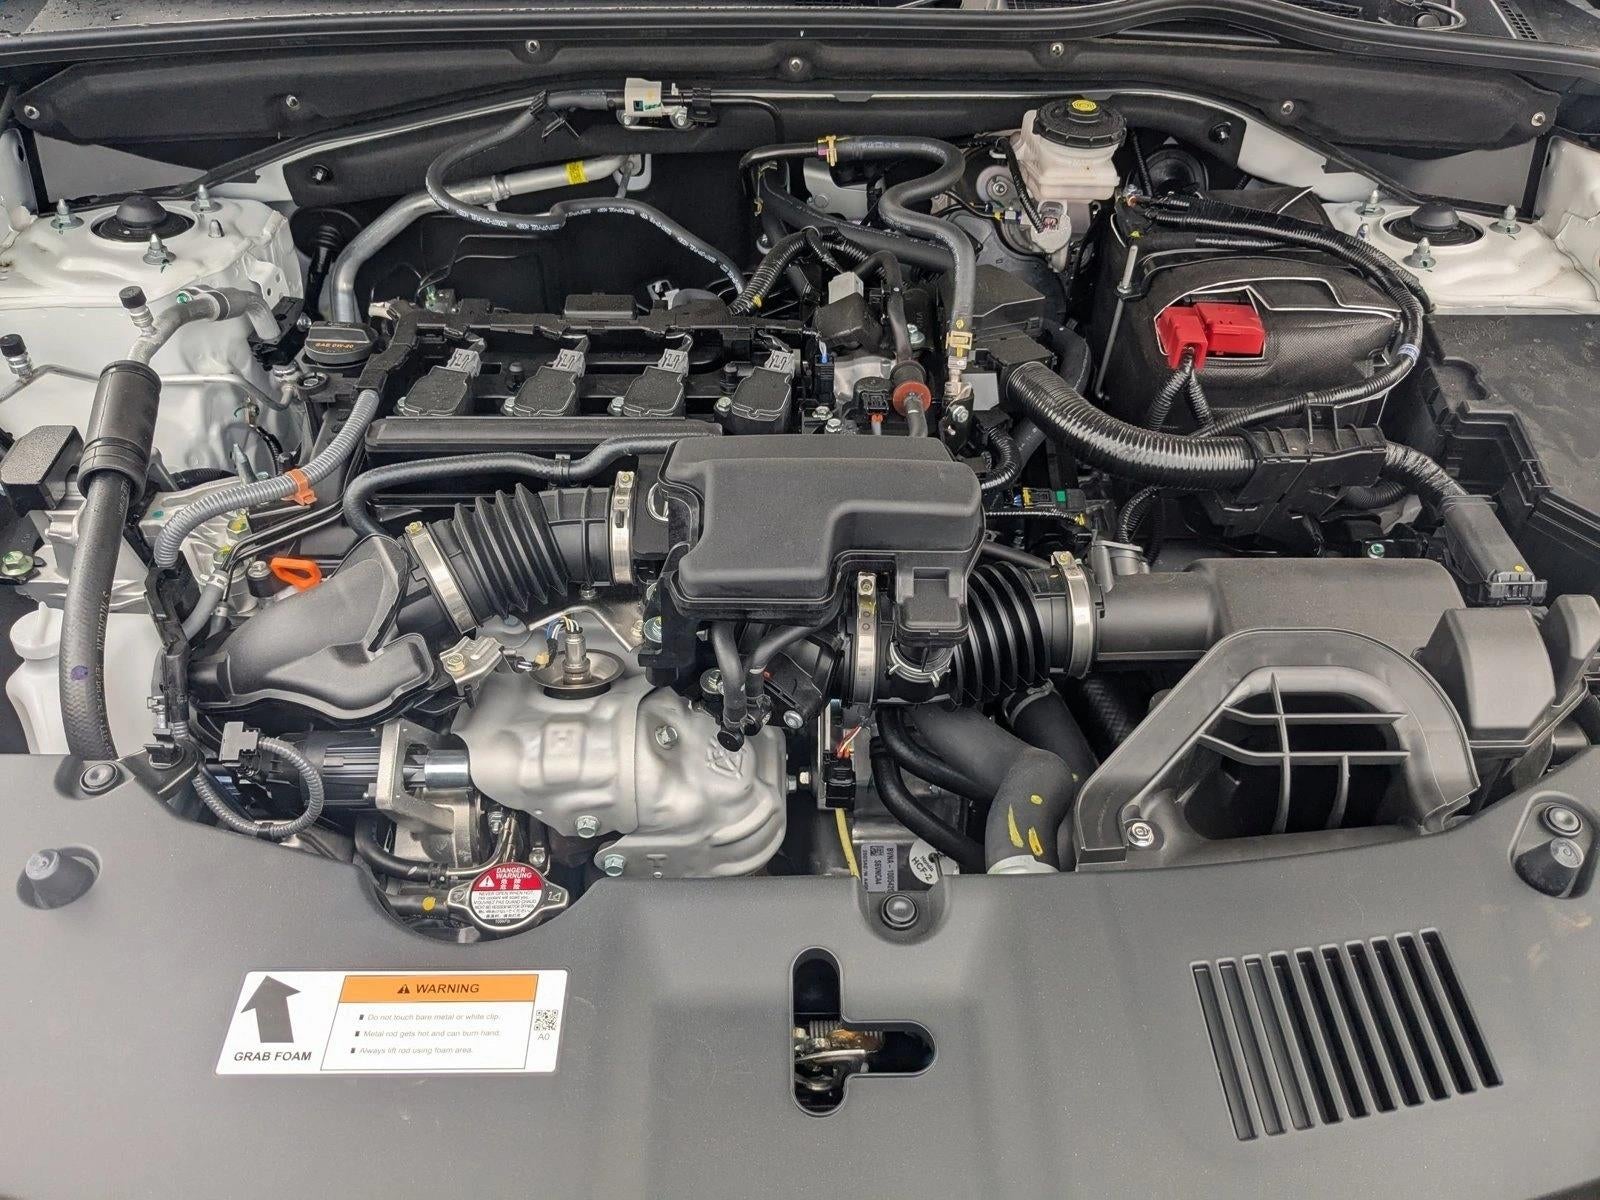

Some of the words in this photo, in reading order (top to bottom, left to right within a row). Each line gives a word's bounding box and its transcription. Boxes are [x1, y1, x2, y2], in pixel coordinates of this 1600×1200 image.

[911, 856, 933, 881] HCF-2
[416, 983, 480, 994] WARNING
[399, 1030, 416, 1039] gets
[233, 1051, 271, 1062] GRAB
[274, 1051, 312, 1062] FOAM
[359, 1047, 386, 1055] Always
[412, 1047, 433, 1056] using
